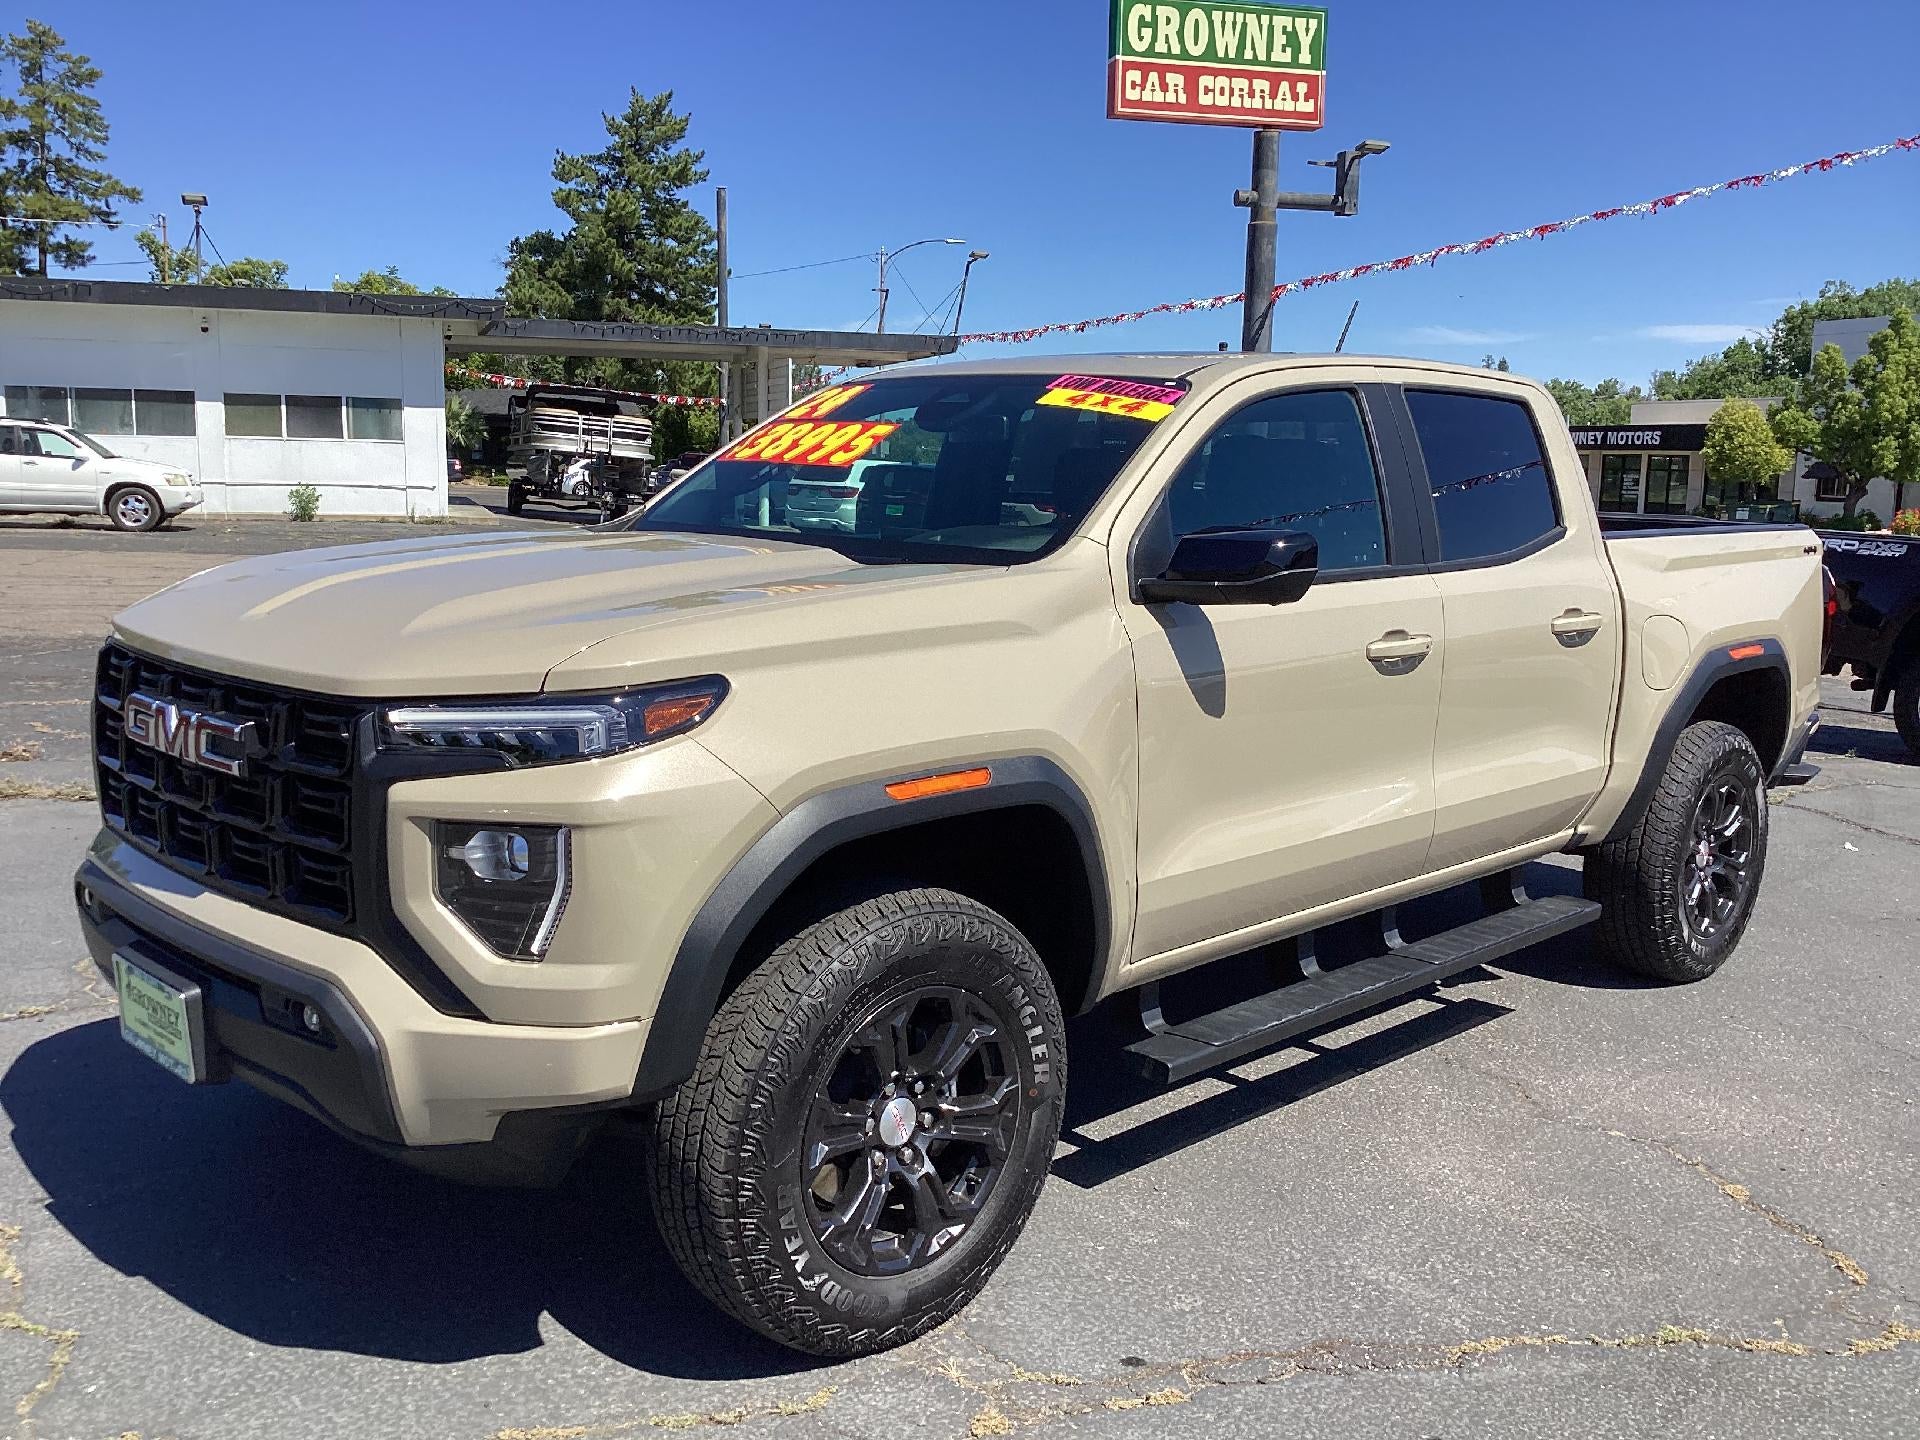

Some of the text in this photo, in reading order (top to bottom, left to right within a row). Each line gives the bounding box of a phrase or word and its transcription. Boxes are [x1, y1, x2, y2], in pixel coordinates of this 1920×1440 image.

[1127, 3, 1318, 65] GROWNEY
[1125, 69, 1315, 113] CAR CORRAL
[1607, 431, 1662, 445] MOTORS
[1821, 539, 1860, 552] RD
[124, 691, 252, 777] GMC
